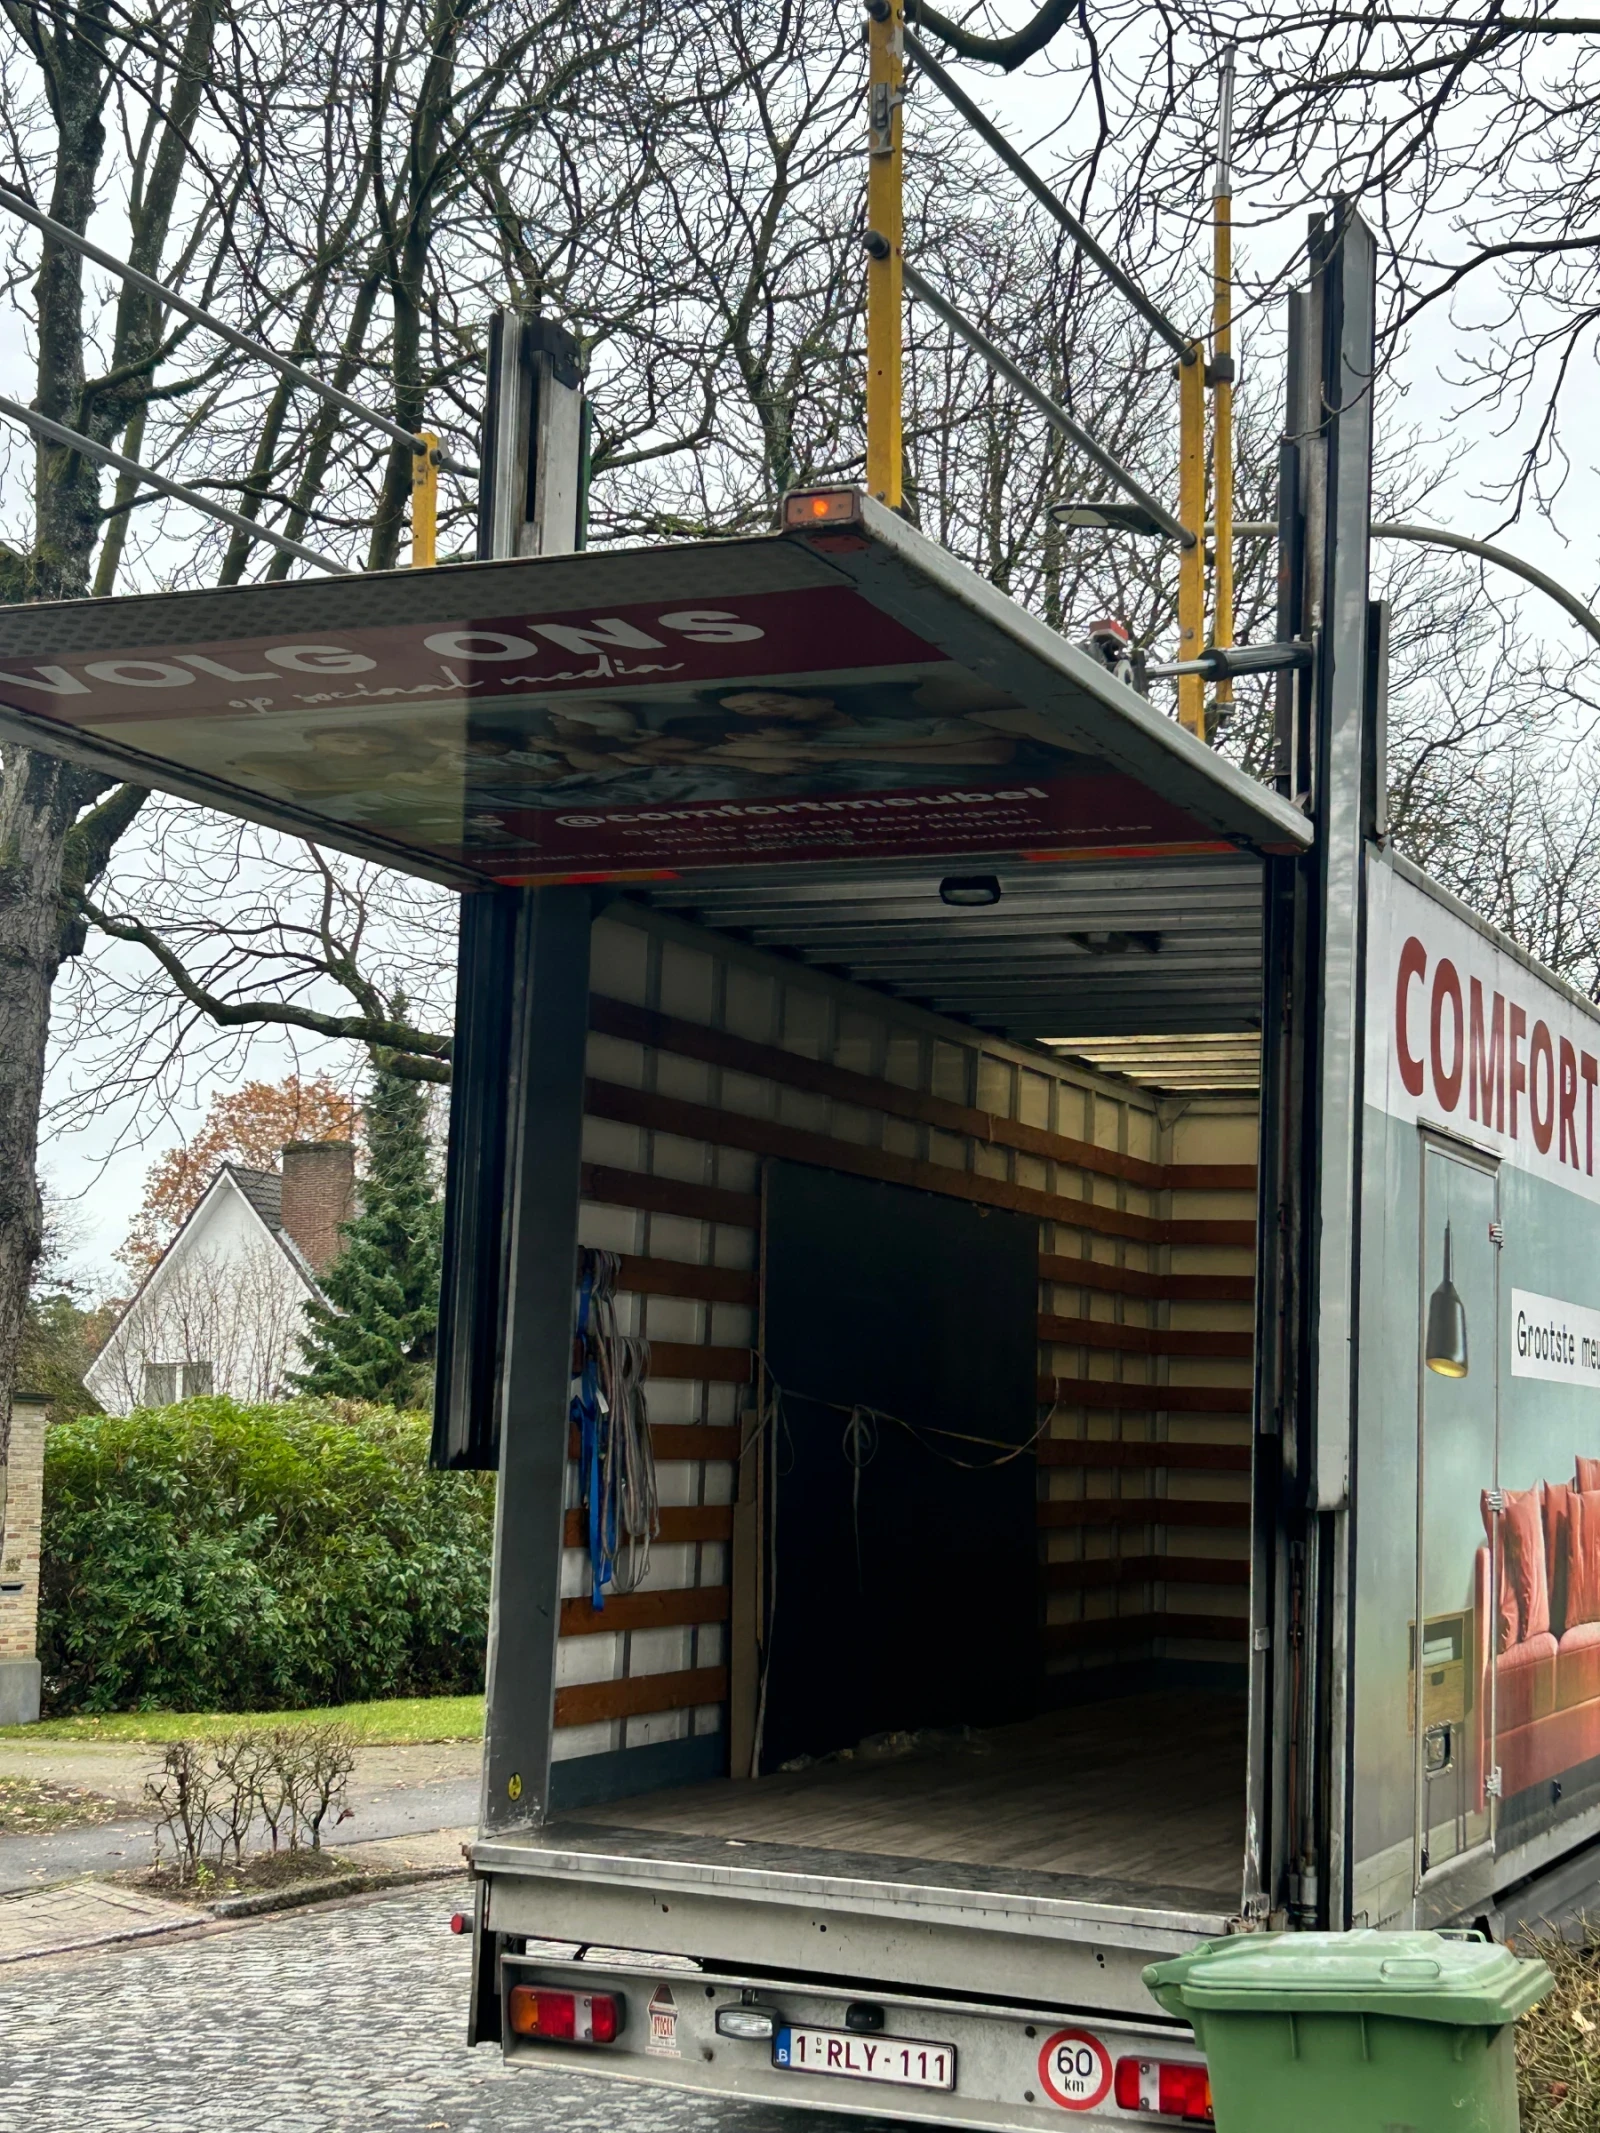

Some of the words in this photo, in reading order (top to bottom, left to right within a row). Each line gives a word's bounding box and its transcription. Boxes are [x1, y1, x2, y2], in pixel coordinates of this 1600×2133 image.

[0, 644, 377, 695] VOLG
[423, 610, 766, 662] ONS
[228, 695, 274, 715] op
[500, 653, 685, 686] media
[555, 786, 1050, 828] @comfortmeubel
[621, 826, 696, 837] Open
[653, 834, 738, 844] Gratis
[859, 823, 920, 833] voor
[928, 817, 1043, 829] klanten
[1395, 935, 1599, 1178] COMFORT
[1517, 1310, 1575, 1366] Grootste
[778, 2048, 789, 2063] B
[1057, 2046, 1093, 2077] 60
[1064, 2076, 1085, 2093] km
